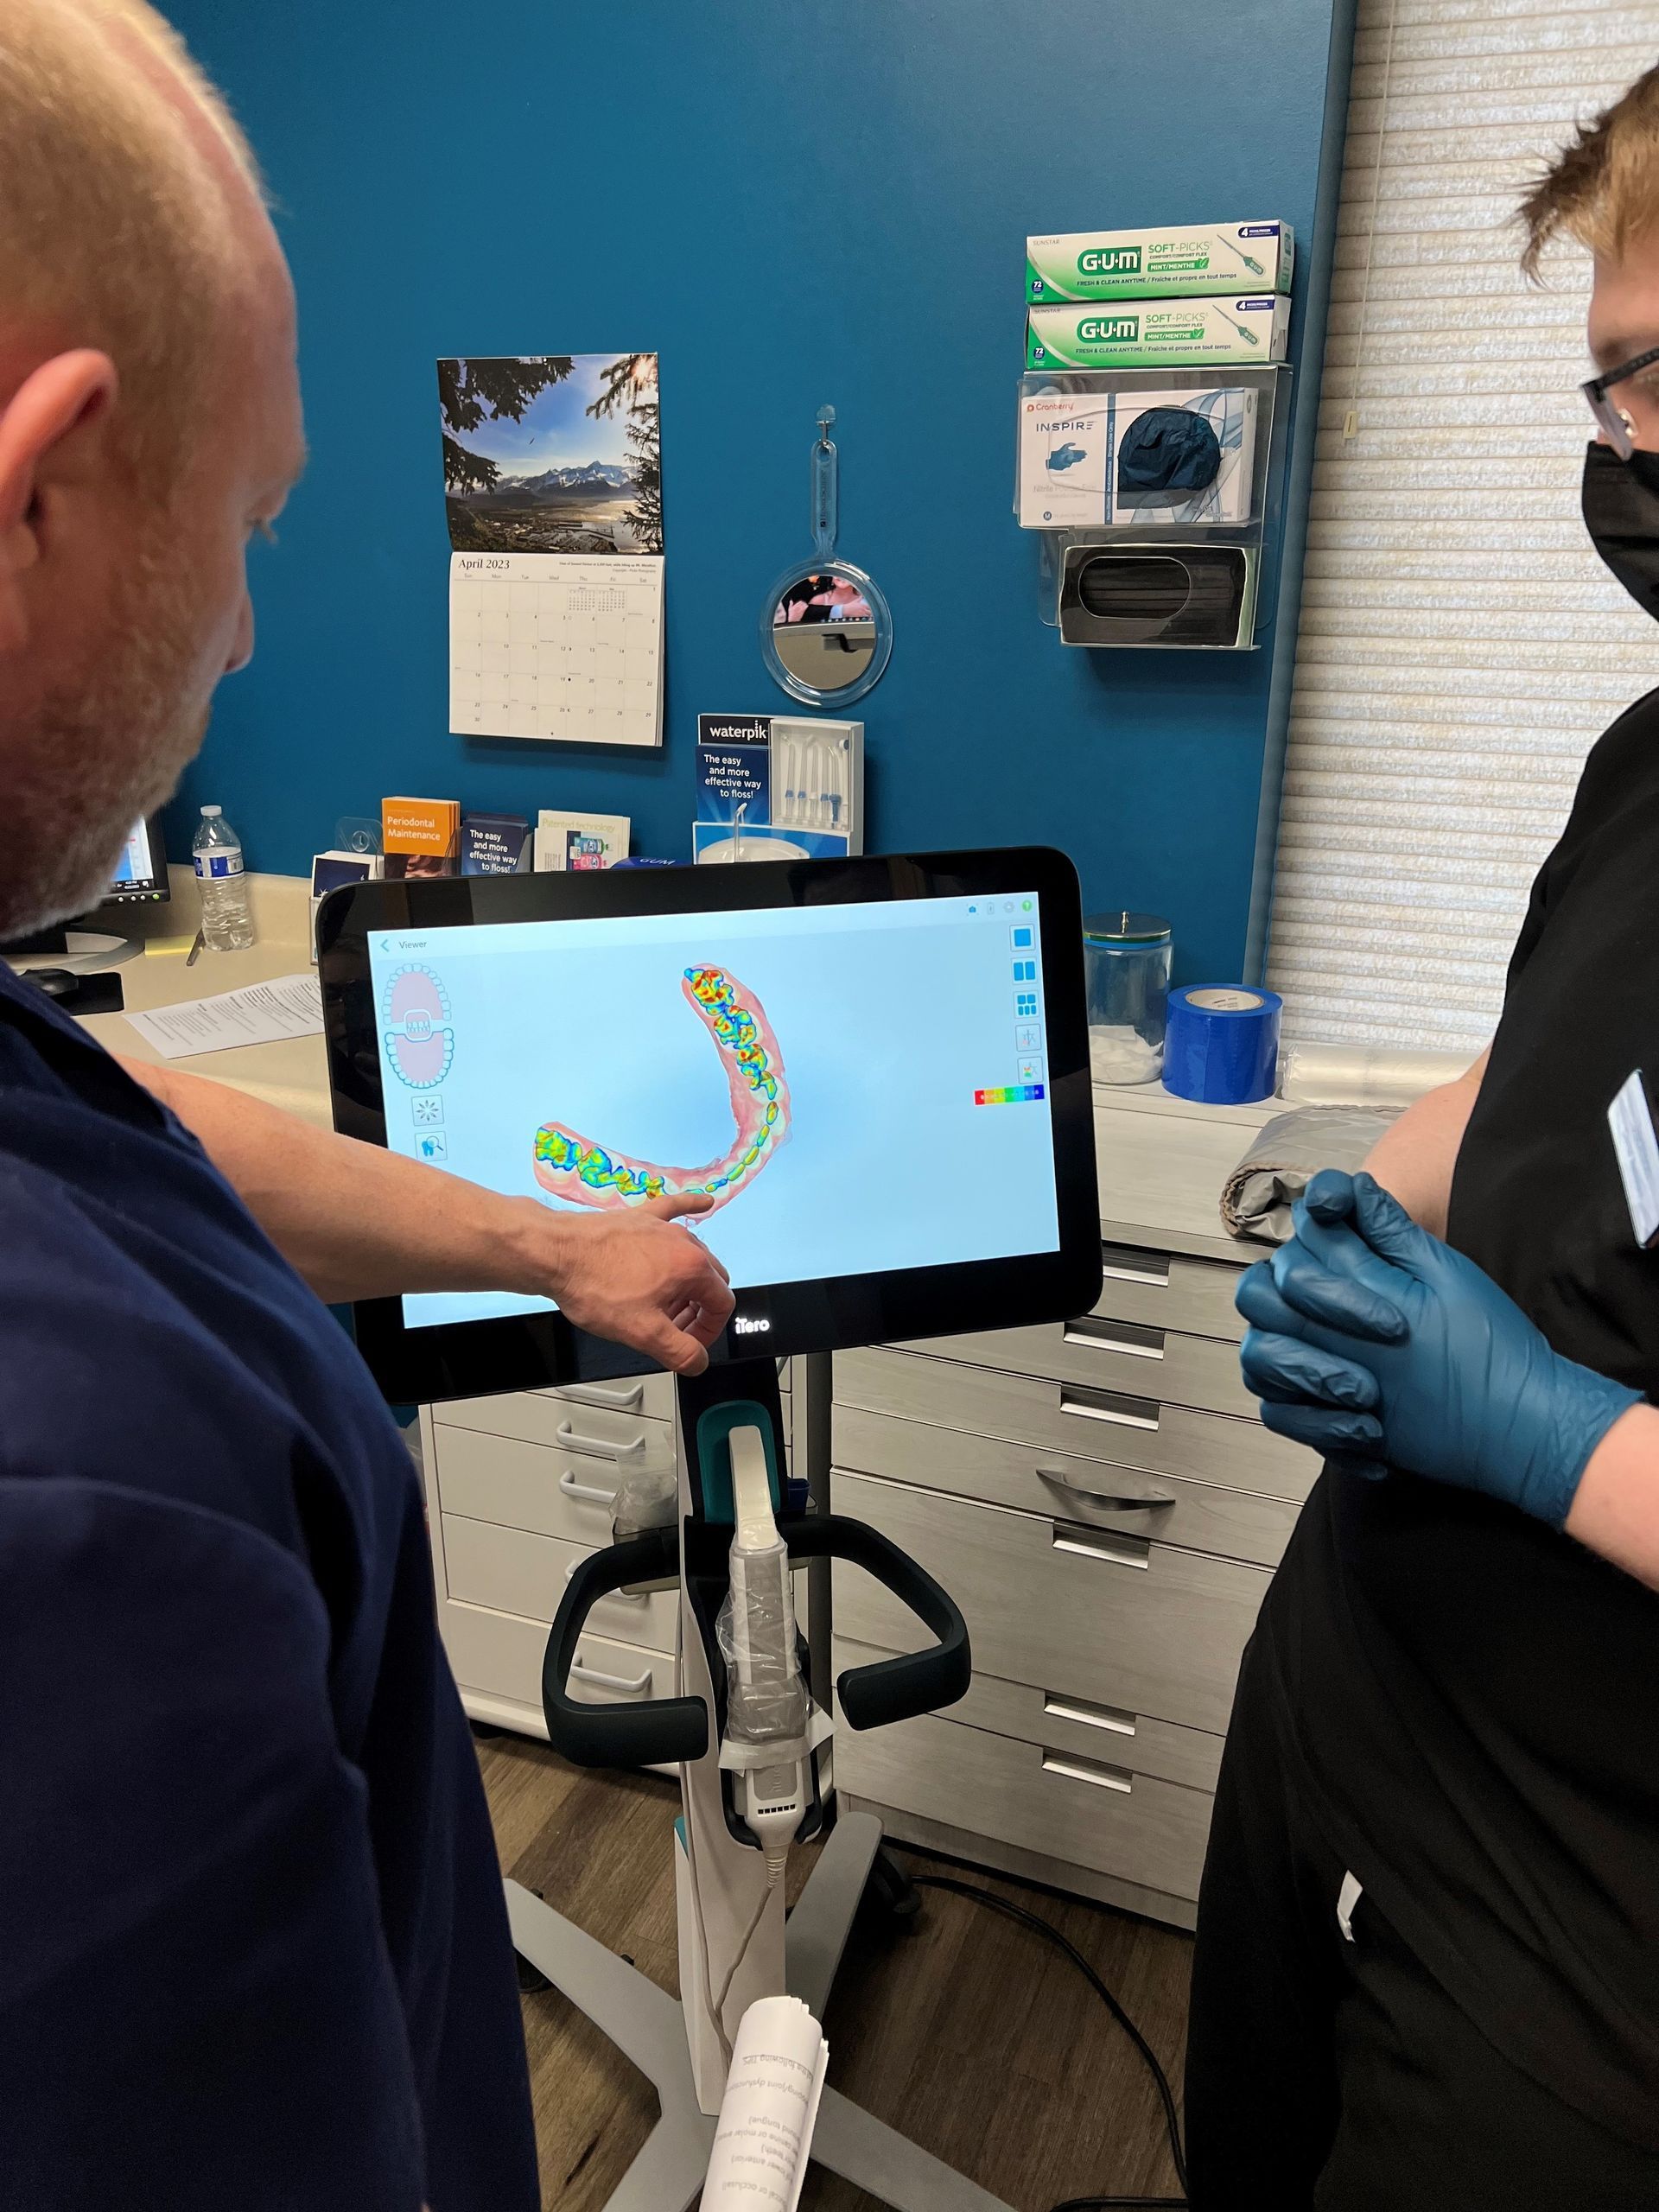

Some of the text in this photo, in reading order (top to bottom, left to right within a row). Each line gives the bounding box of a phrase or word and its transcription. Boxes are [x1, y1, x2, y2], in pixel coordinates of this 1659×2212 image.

[1241, 227, 1249, 237] 4
[1239, 301, 1246, 310] 4
[1036, 403, 1074, 412] Cranberry
[1036, 421, 1095, 432] INSPIRE
[458, 558, 511, 570] April 2023
[709, 721, 767, 741] waterpik
[703, 753, 741, 766] The easy
[709, 766, 750, 777] and more
[704, 777, 761, 791] effective way
[720, 789, 753, 799] to floss!
[387, 816, 435, 828] Periodontal
[543, 818, 616, 834] Patented technology
[387, 829, 441, 841] Maintenance
[469, 830, 501, 843] The easy
[474, 842, 508, 853] and more
[469, 851, 518, 866] effective way
[481, 861, 511, 874] to floss!
[398, 941, 427, 950] Viewer
[734, 1317, 770, 1335] iTero
[748, 2115, 780, 2130] tongue)
[734, 2130, 757, 2139] molar
